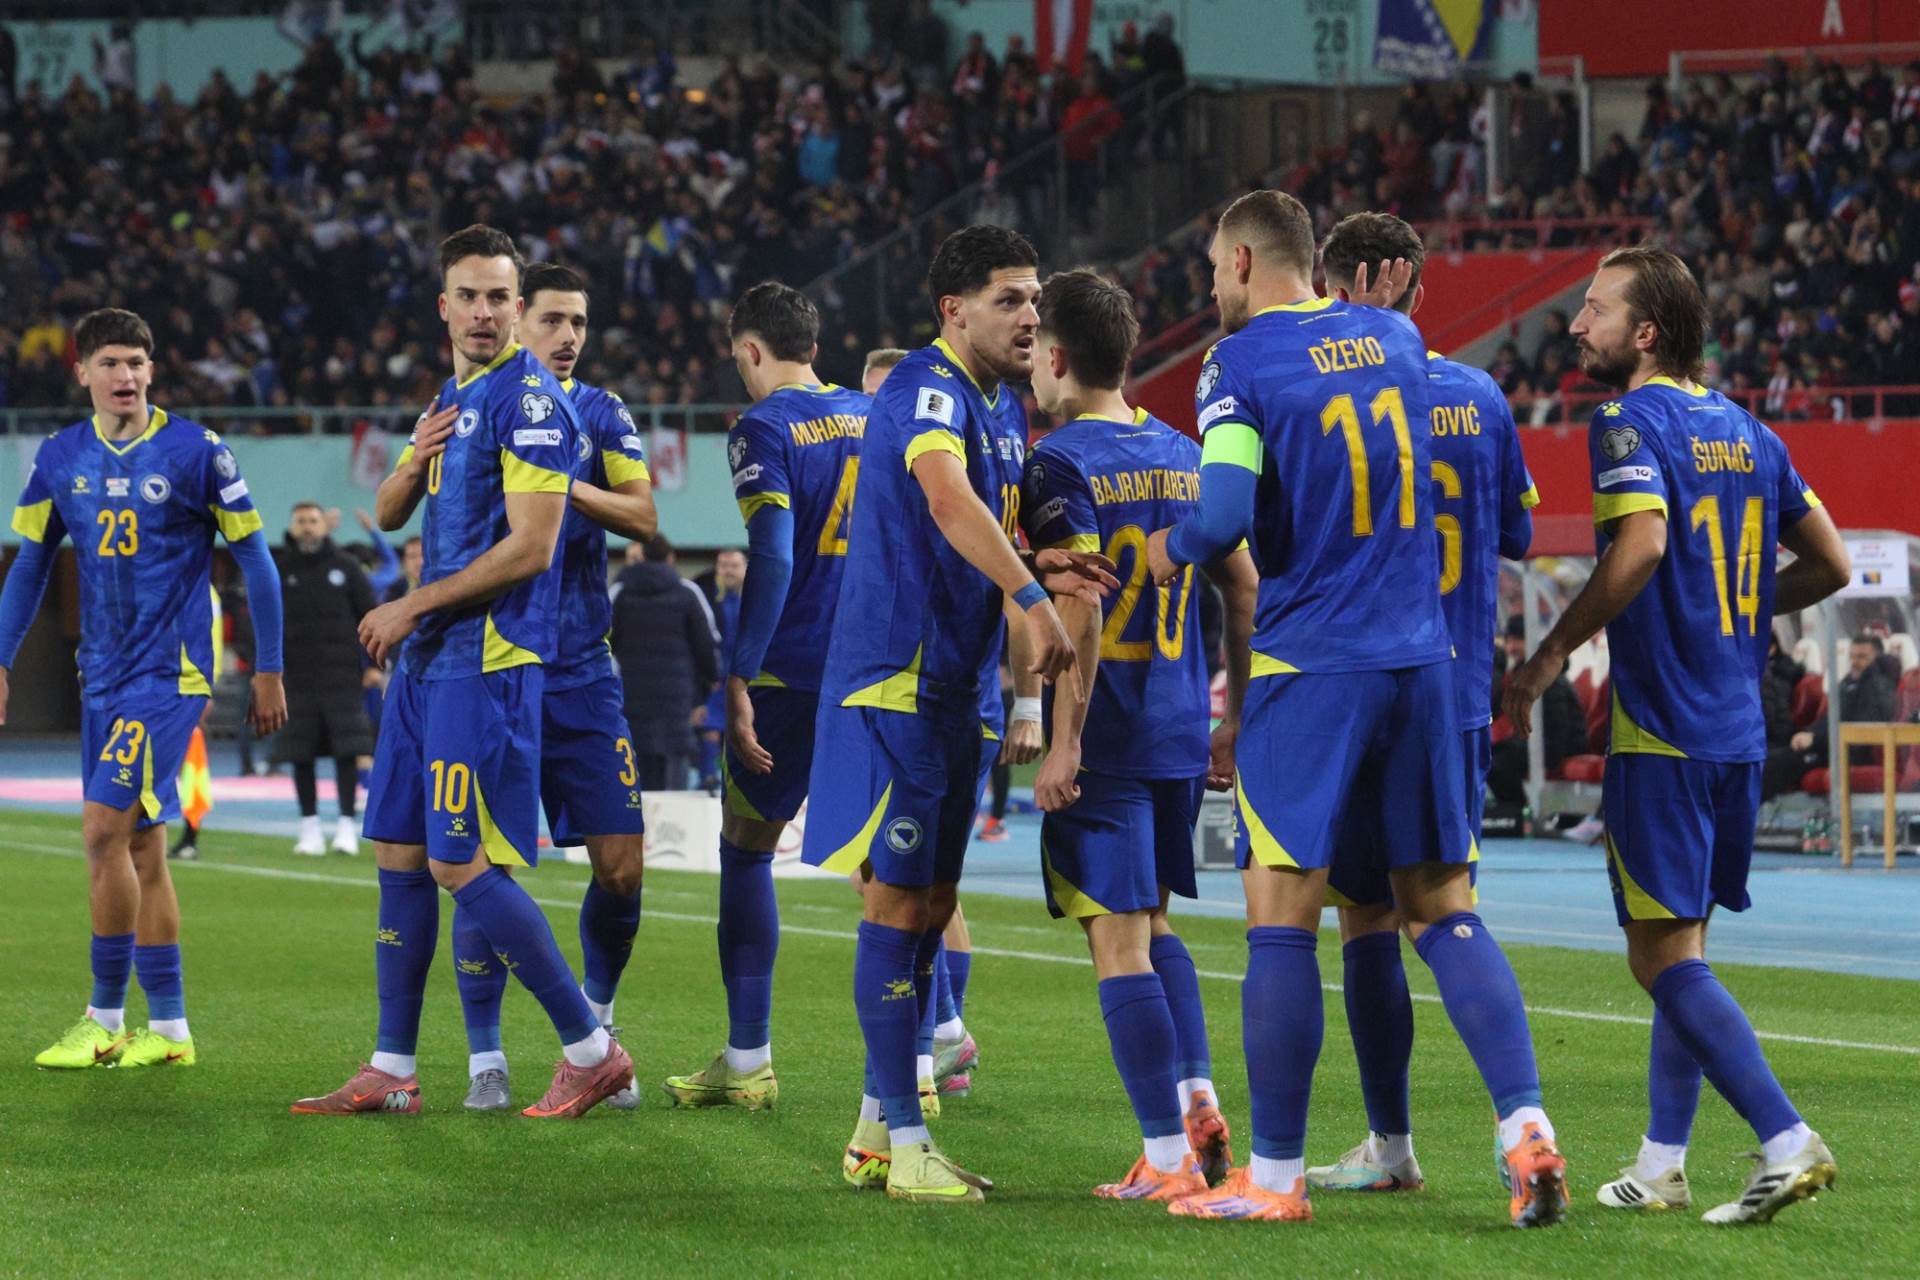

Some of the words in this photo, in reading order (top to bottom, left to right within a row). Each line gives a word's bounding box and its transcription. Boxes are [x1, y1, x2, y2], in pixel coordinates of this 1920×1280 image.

[1312, 18, 1348, 54] 28
[1308, 336, 1386, 374] DŽEKO
[1429, 400, 1481, 436] OVIĆ
[1320, 386, 1416, 537] 11
[97, 509, 139, 556] 23
[1690, 495, 1763, 636] 14
[1100, 524, 1195, 661] 20
[99, 718, 145, 766] 23
[430, 760, 470, 814] 10
[881, 990, 916, 1001] KELM
